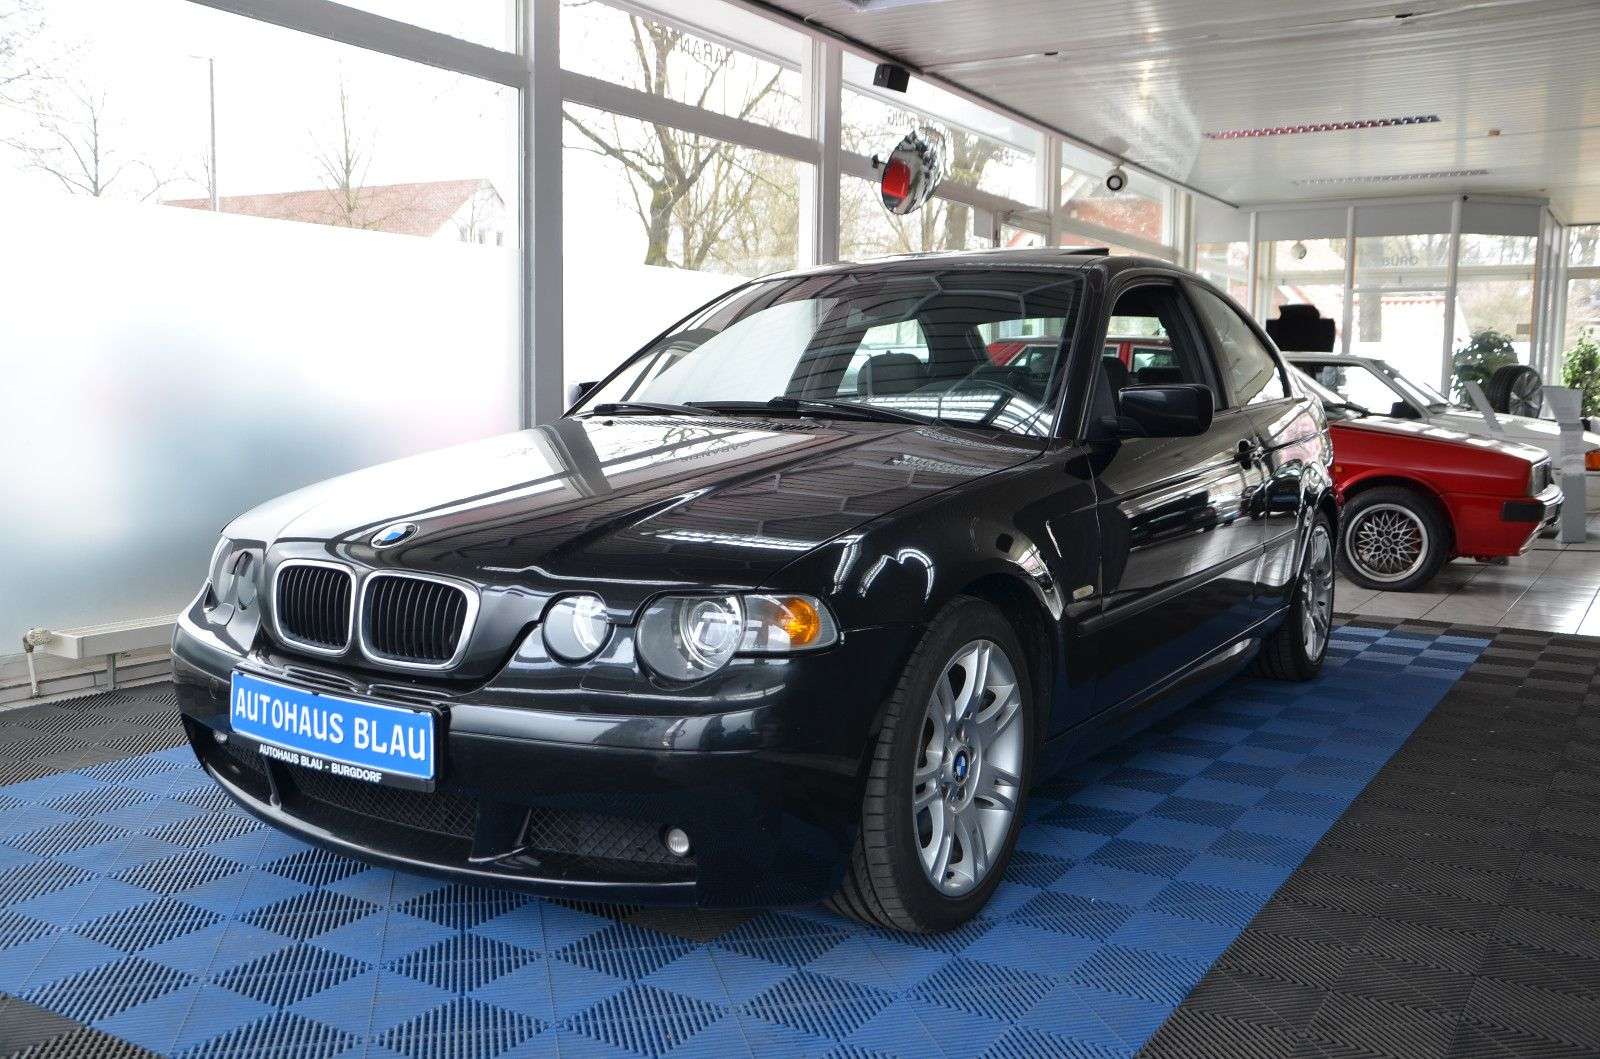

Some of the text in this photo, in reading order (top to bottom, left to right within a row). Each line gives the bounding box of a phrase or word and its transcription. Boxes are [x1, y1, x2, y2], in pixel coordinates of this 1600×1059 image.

[235, 687, 426, 761] AUTOHAUS BLAU
[259, 743, 300, 764] AUTOHAUS
[300, 755, 323, 770] BLAU
[331, 763, 382, 783] BURGDORF
